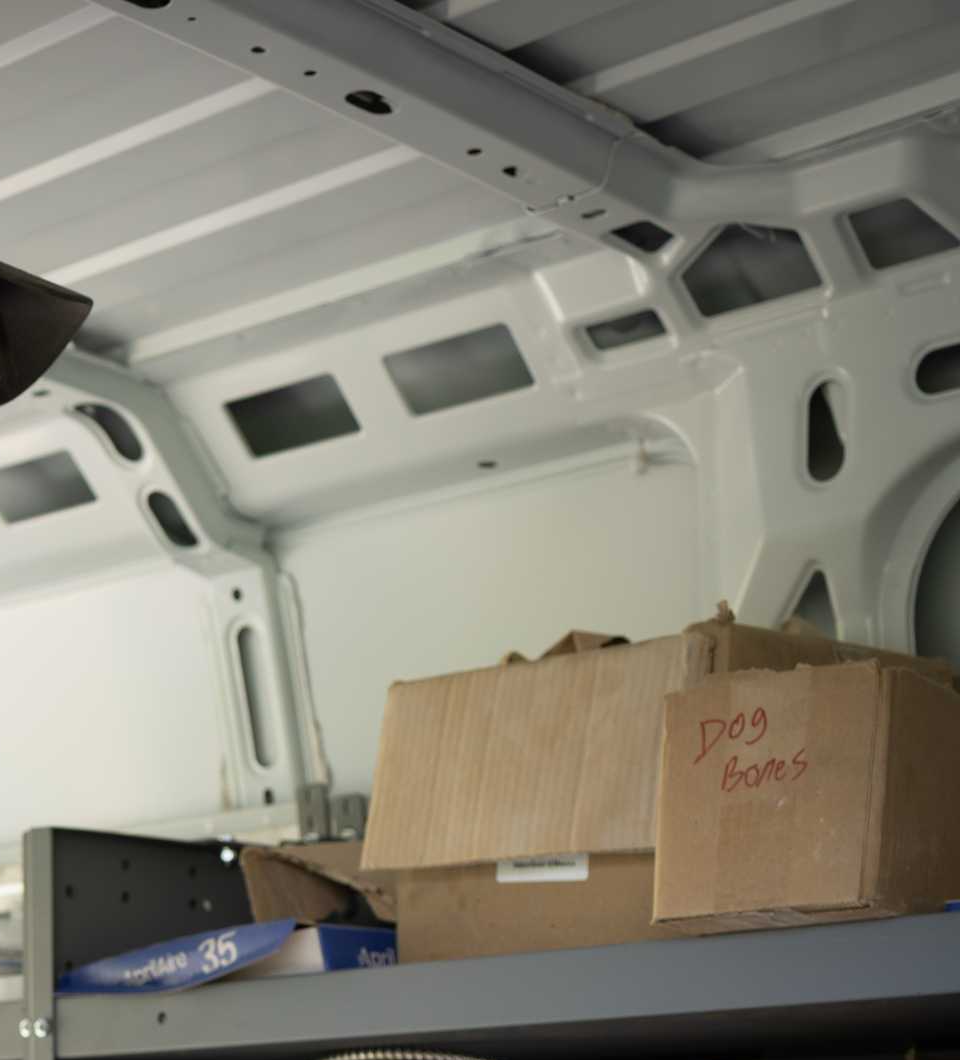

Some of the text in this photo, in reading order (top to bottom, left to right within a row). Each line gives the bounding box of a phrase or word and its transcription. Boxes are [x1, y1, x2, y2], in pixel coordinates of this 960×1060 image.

[693, 706, 768, 765] Dog
[721, 748, 808, 792] Bones
[197, 929, 238, 974] 35
